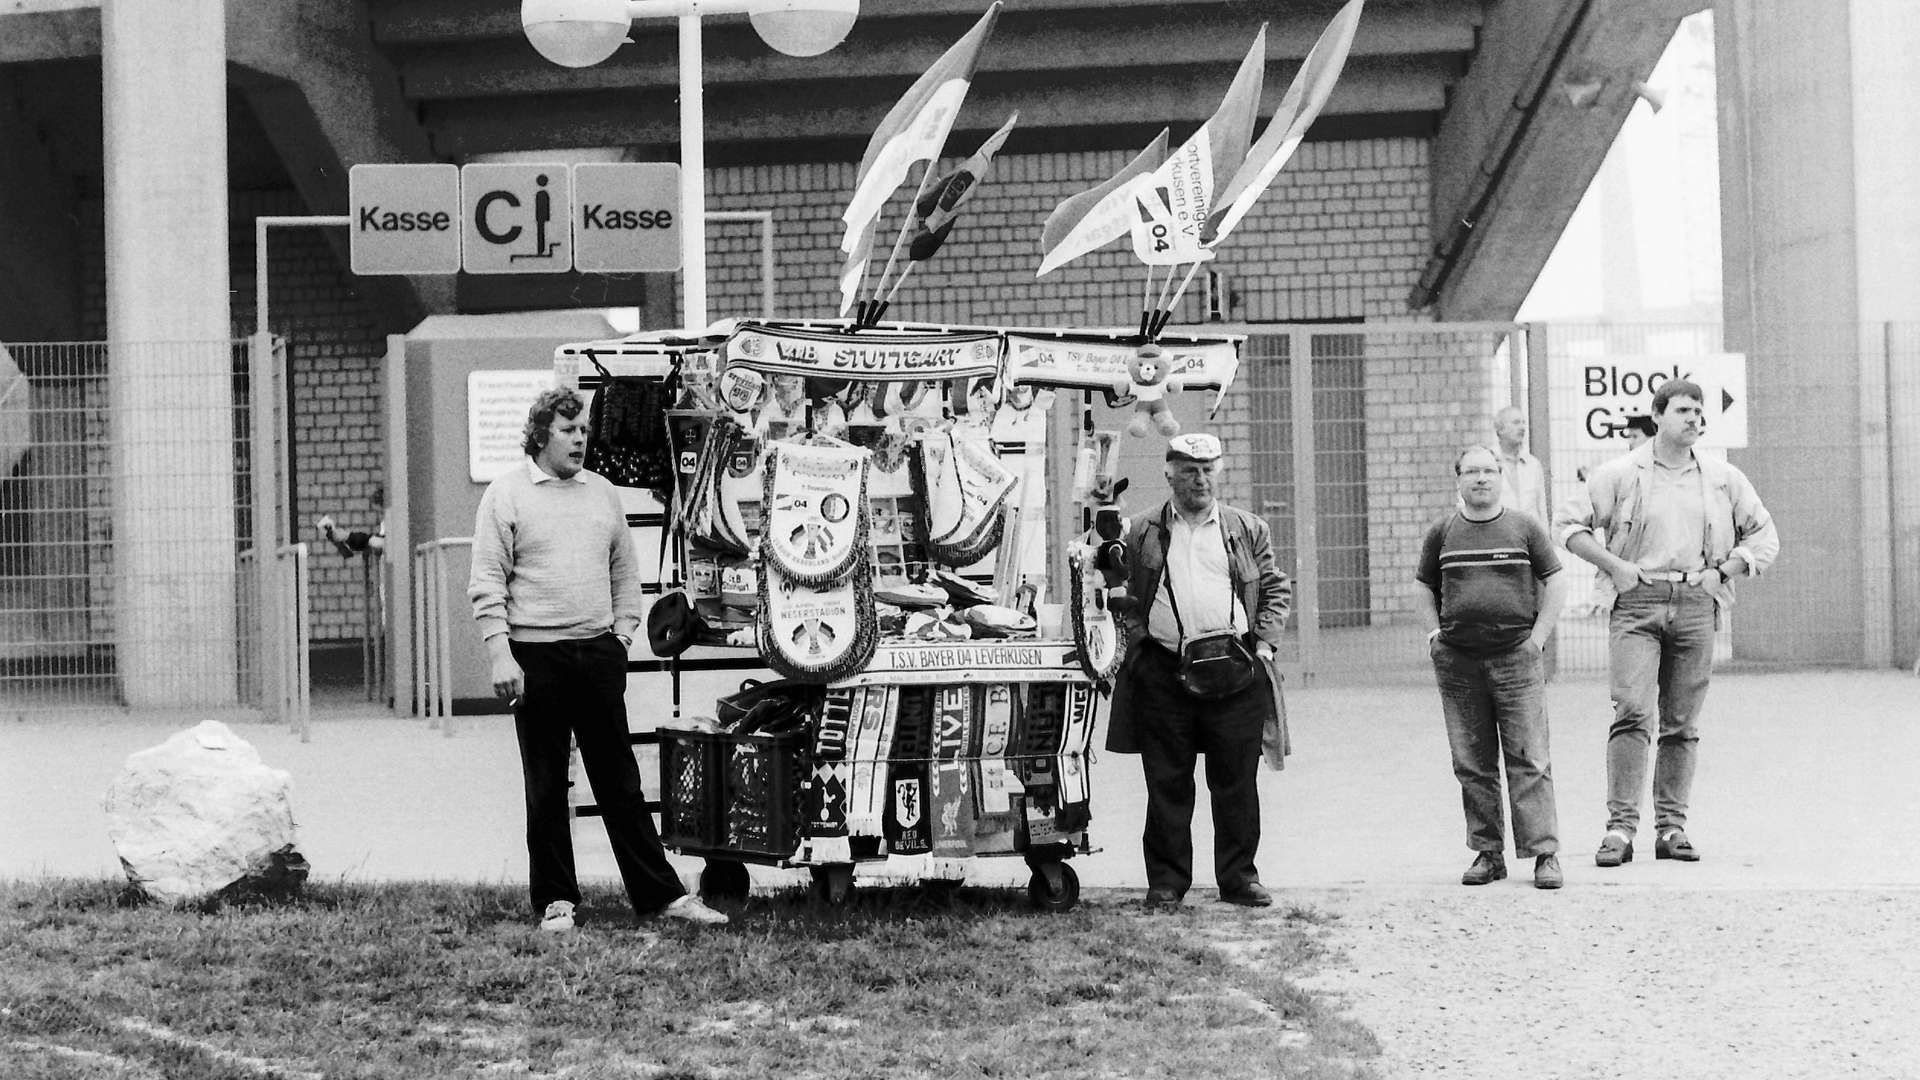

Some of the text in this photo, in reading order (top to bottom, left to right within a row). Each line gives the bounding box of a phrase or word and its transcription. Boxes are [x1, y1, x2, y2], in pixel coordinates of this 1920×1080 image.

[359, 206, 450, 232] Kasse
[582, 204, 673, 230] Kasse
[1152, 224, 1170, 253] 04
[833, 348, 961, 370] STUTTGART
[1039, 352, 1055, 364] 04
[1187, 358, 1205, 369] 04
[682, 456, 696, 469] 04
[794, 499, 808, 508] 04
[889, 648, 1043, 669] T.S.V. BAYER 04 LEVERKUSEN
[901, 830, 918, 840] RED
[894, 839, 929, 850] DEVILS
